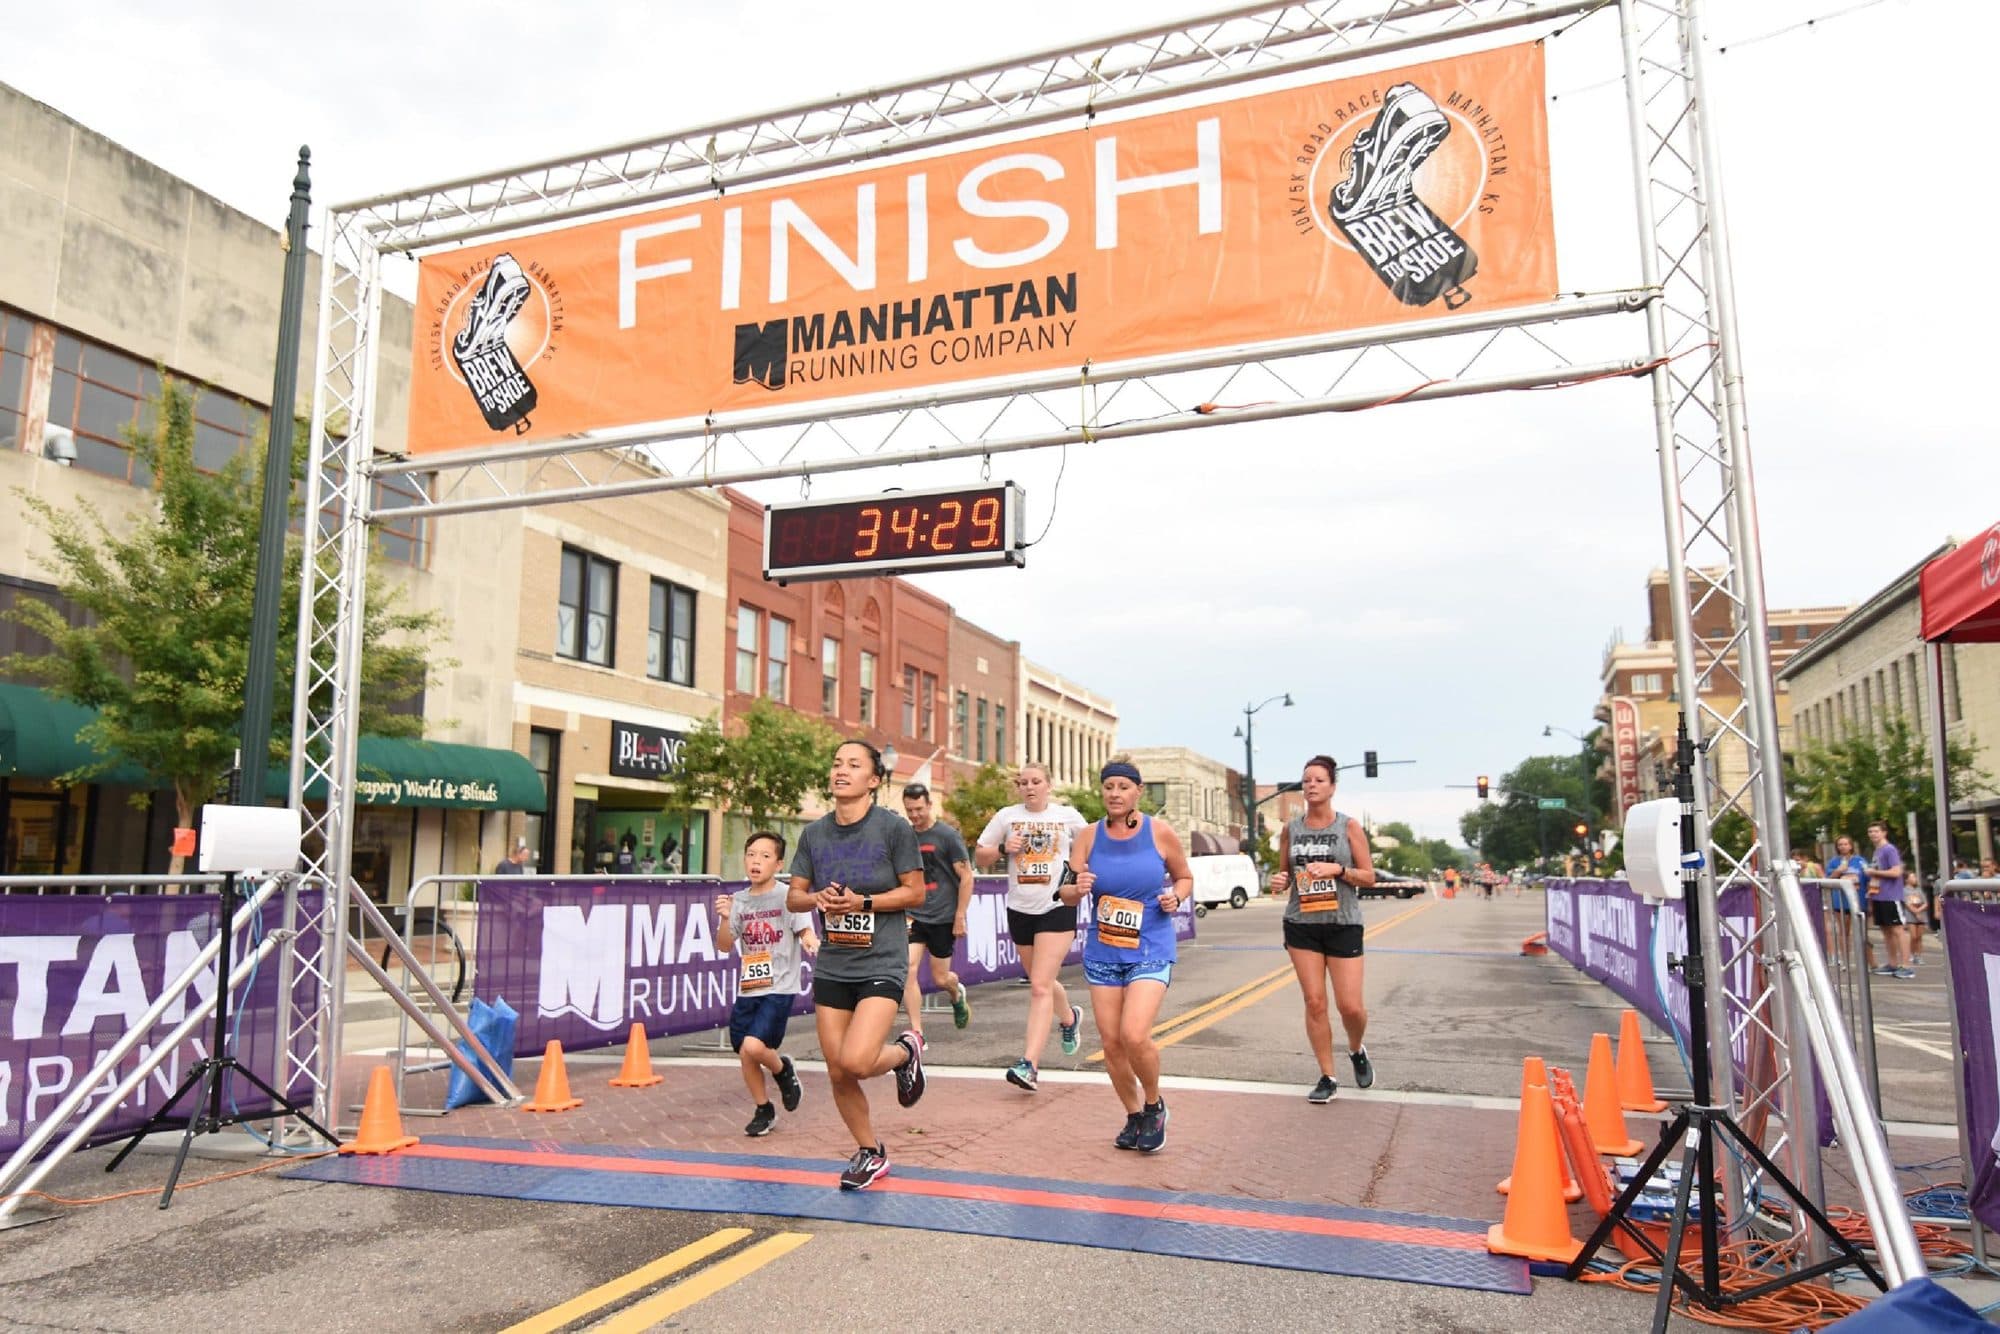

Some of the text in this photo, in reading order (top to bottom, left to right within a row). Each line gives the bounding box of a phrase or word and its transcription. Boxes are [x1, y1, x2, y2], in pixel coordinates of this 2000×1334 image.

[1289, 90, 1380, 235] 10K/5K ROAD RACE
[1478, 193, 1500, 214] KS
[618, 117, 1222, 329] FINISH
[1345, 202, 1438, 265] BREW
[1381, 231, 1464, 283] TO SHOE
[791, 271, 1078, 353] MANHATTAN
[790, 319, 1077, 384] RUNNING COMPANY
[462, 347, 516, 398] BREW
[481, 373, 531, 414] TO SHOE
[619, 730, 687, 766] BLNG
[354, 778, 498, 804] rapery World & Blinds
[1031, 863, 1049, 874] 319
[1313, 879, 1333, 892] 004
[844, 914, 871, 931] 562
[1115, 911, 1137, 927] 001
[748, 963, 771, 978] 563
